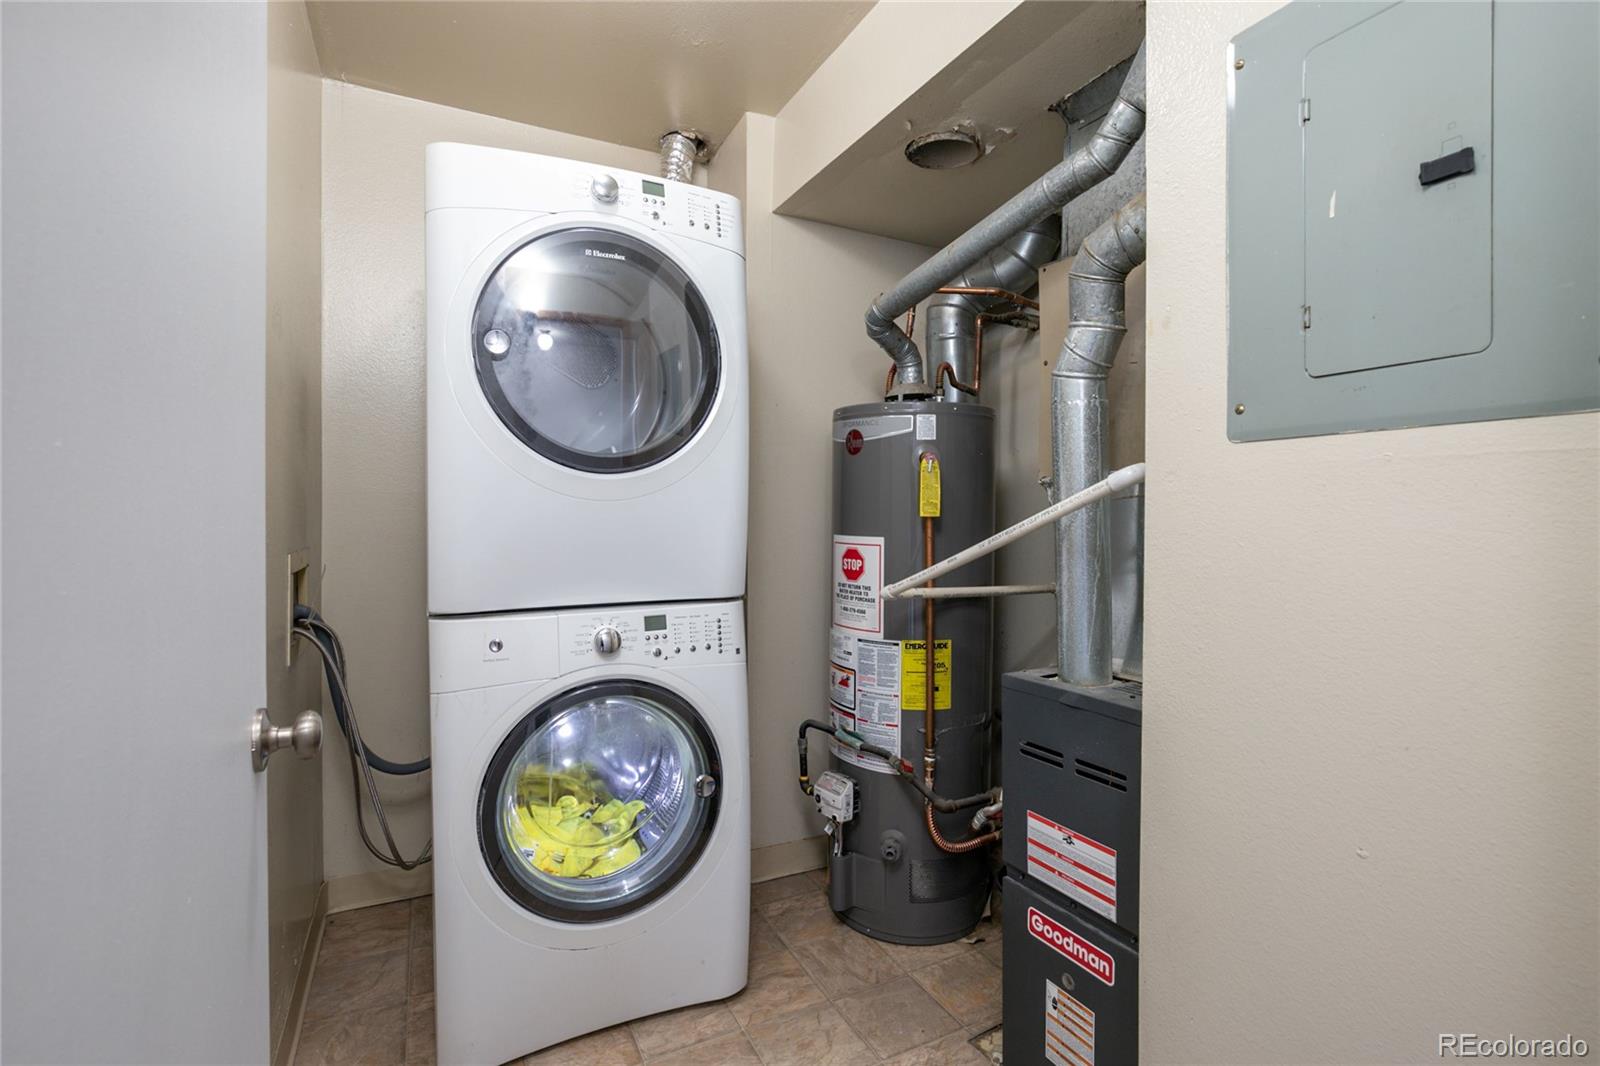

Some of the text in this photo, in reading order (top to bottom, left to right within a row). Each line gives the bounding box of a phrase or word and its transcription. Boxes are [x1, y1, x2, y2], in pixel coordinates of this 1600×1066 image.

[593, 249, 626, 261] Electrolux
[843, 558, 863, 571] STOP
[1031, 914, 1110, 977] Goodman
